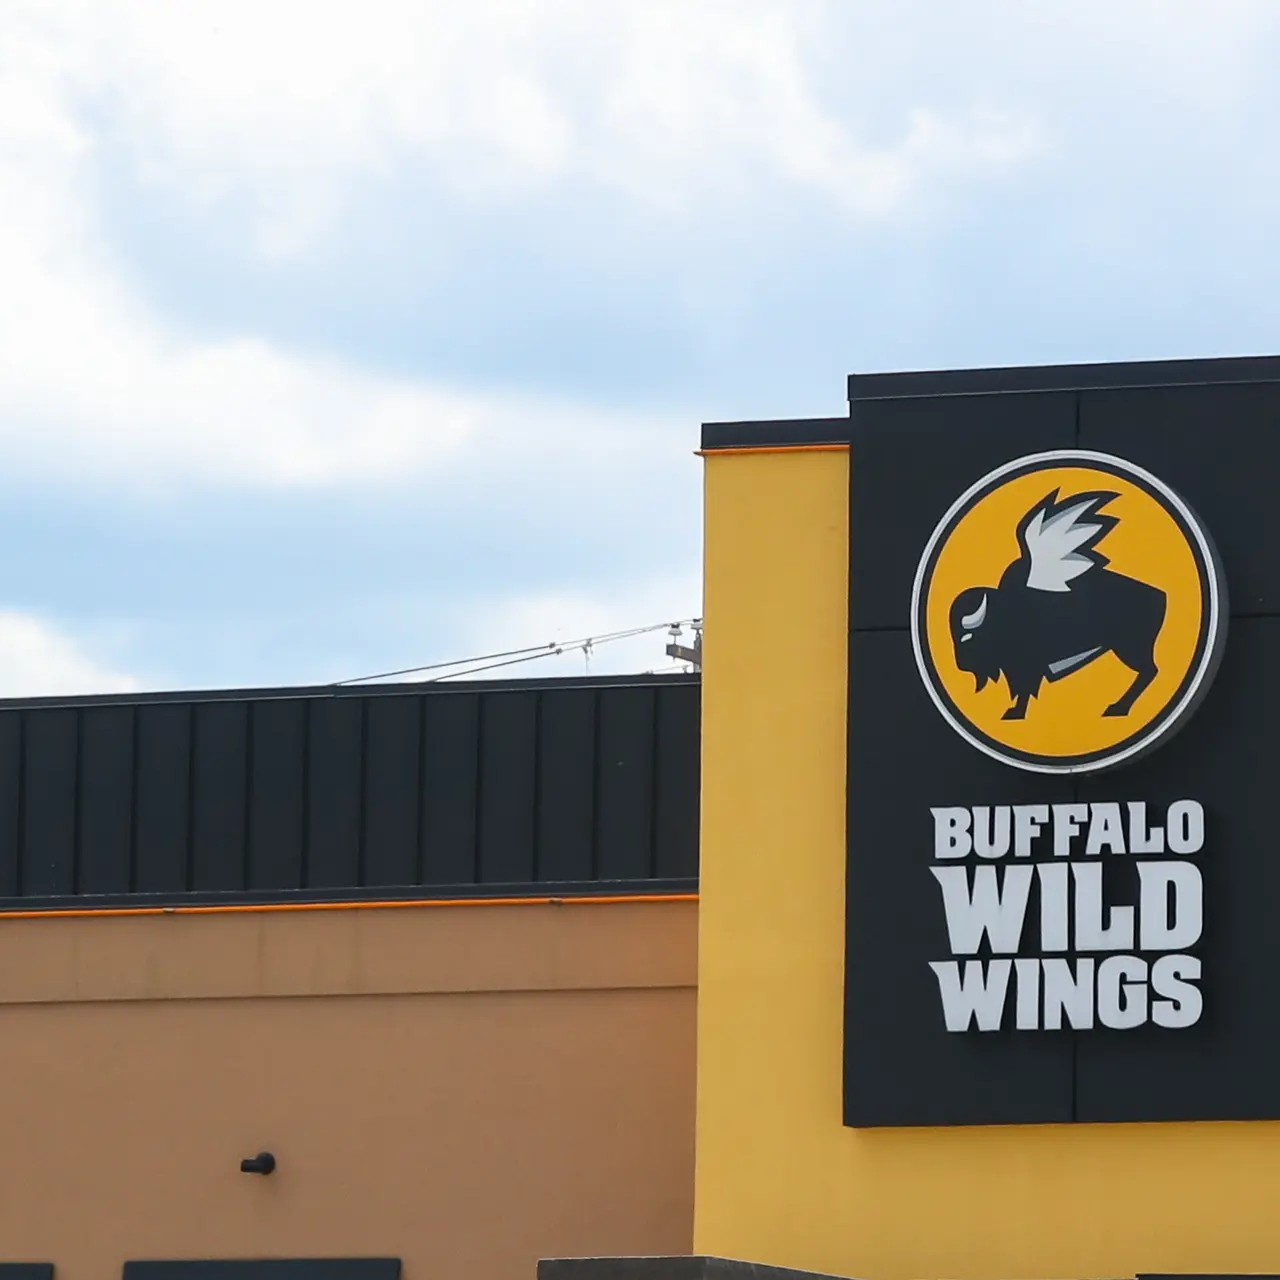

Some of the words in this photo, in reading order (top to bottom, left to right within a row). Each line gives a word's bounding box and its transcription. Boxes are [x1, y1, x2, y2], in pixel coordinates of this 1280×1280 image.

[929, 799, 1205, 859] BUFFALO
[928, 860, 1203, 954] WILD
[928, 954, 1203, 1031] WINGS
